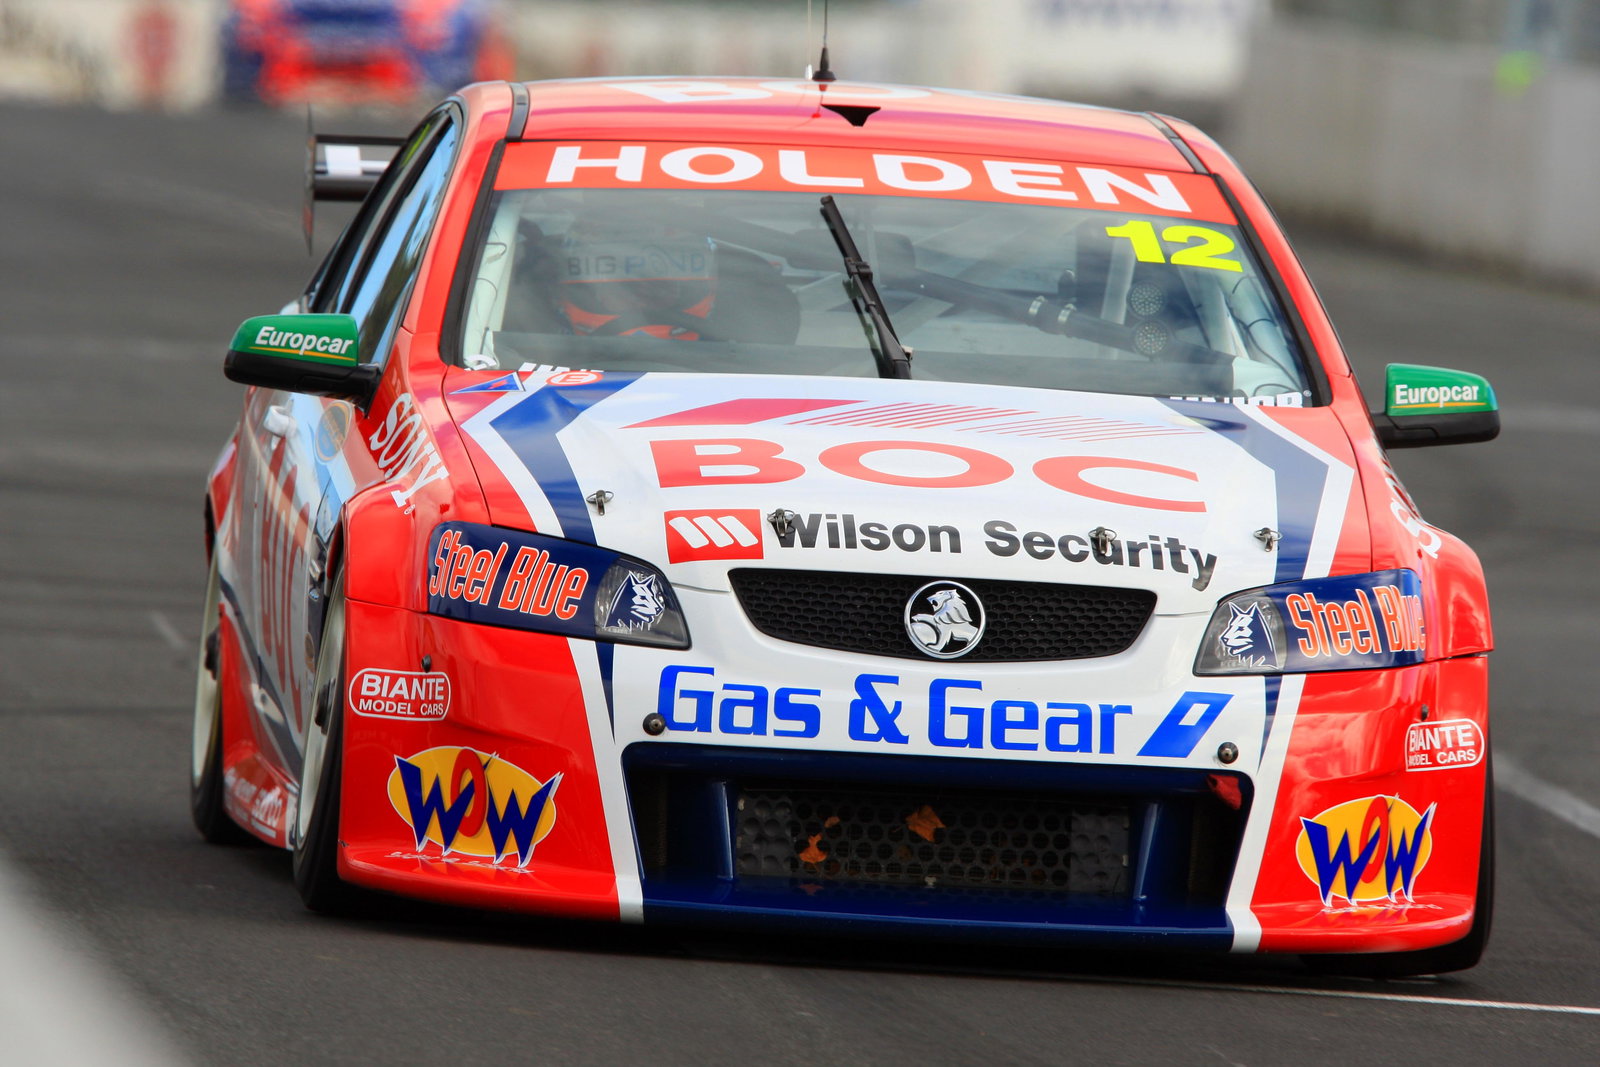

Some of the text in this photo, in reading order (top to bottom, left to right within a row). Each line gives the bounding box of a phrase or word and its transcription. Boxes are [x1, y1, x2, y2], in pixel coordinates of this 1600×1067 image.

[545, 146, 1192, 212] HOLDEN
[1105, 220, 1241, 272] 12
[255, 326, 354, 355] Europcar
[1395, 384, 1480, 408] Europcar
[369, 392, 450, 508] SONY
[649, 438, 1207, 512] BOC
[429, 529, 589, 620] Steel Blue
[770, 511, 1217, 592] Wilson Security
[1286, 588, 1382, 659] Steel
[359, 698, 444, 716] MODEL CARS
[361, 674, 445, 700] BIANTE
[658, 665, 1133, 754] Gas & Gear
[1436, 749, 1477, 764] CARS
[396, 748, 562, 868] WOW
[1301, 796, 1436, 906] WOW
